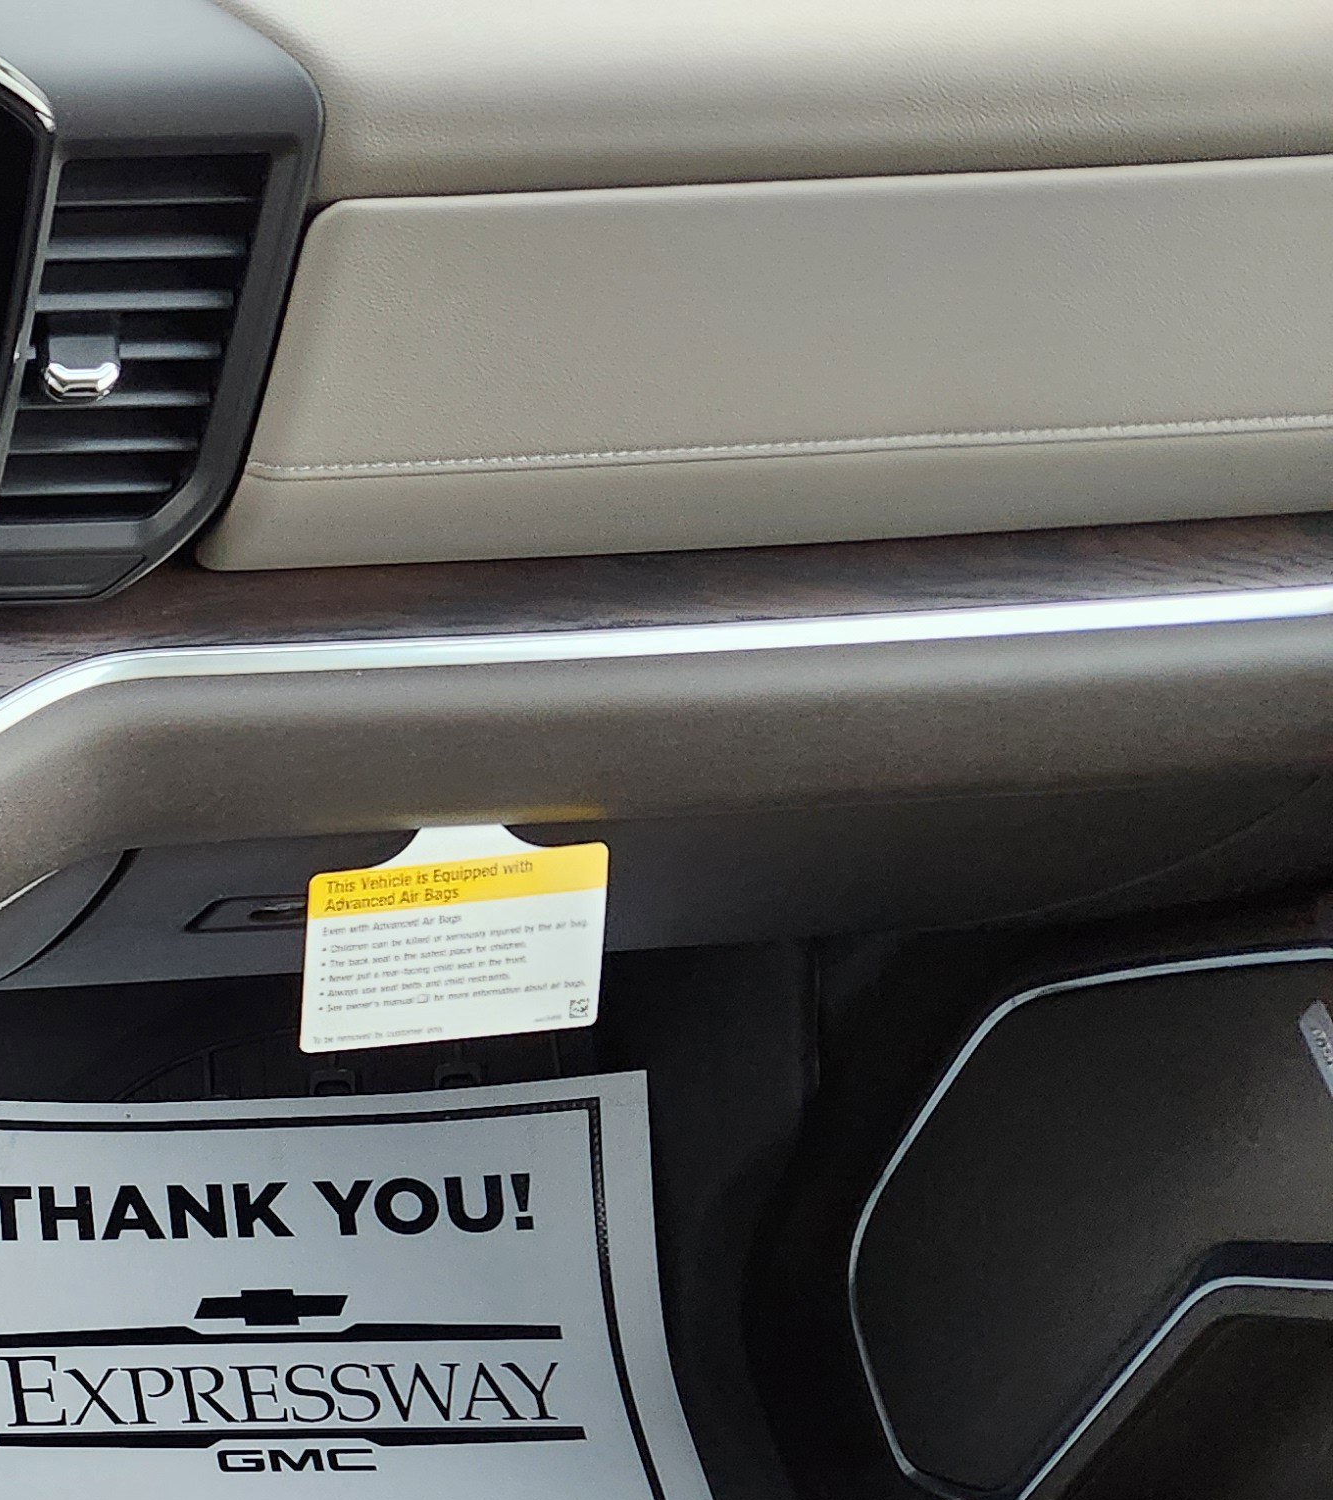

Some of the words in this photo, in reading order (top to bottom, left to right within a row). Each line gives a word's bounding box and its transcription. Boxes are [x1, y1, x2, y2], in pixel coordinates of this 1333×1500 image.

[327, 879, 356, 895] This
[361, 872, 412, 891] Vehicle
[416, 870, 428, 885] is
[433, 863, 498, 883] Equipped
[503, 859, 533, 875] with
[325, 894, 396, 912] Advanced
[400, 890, 419, 905] Air
[425, 886, 460, 903] Bags
[312, 1173, 535, 1238] YOU!
[217, 1447, 378, 1474] GMC
